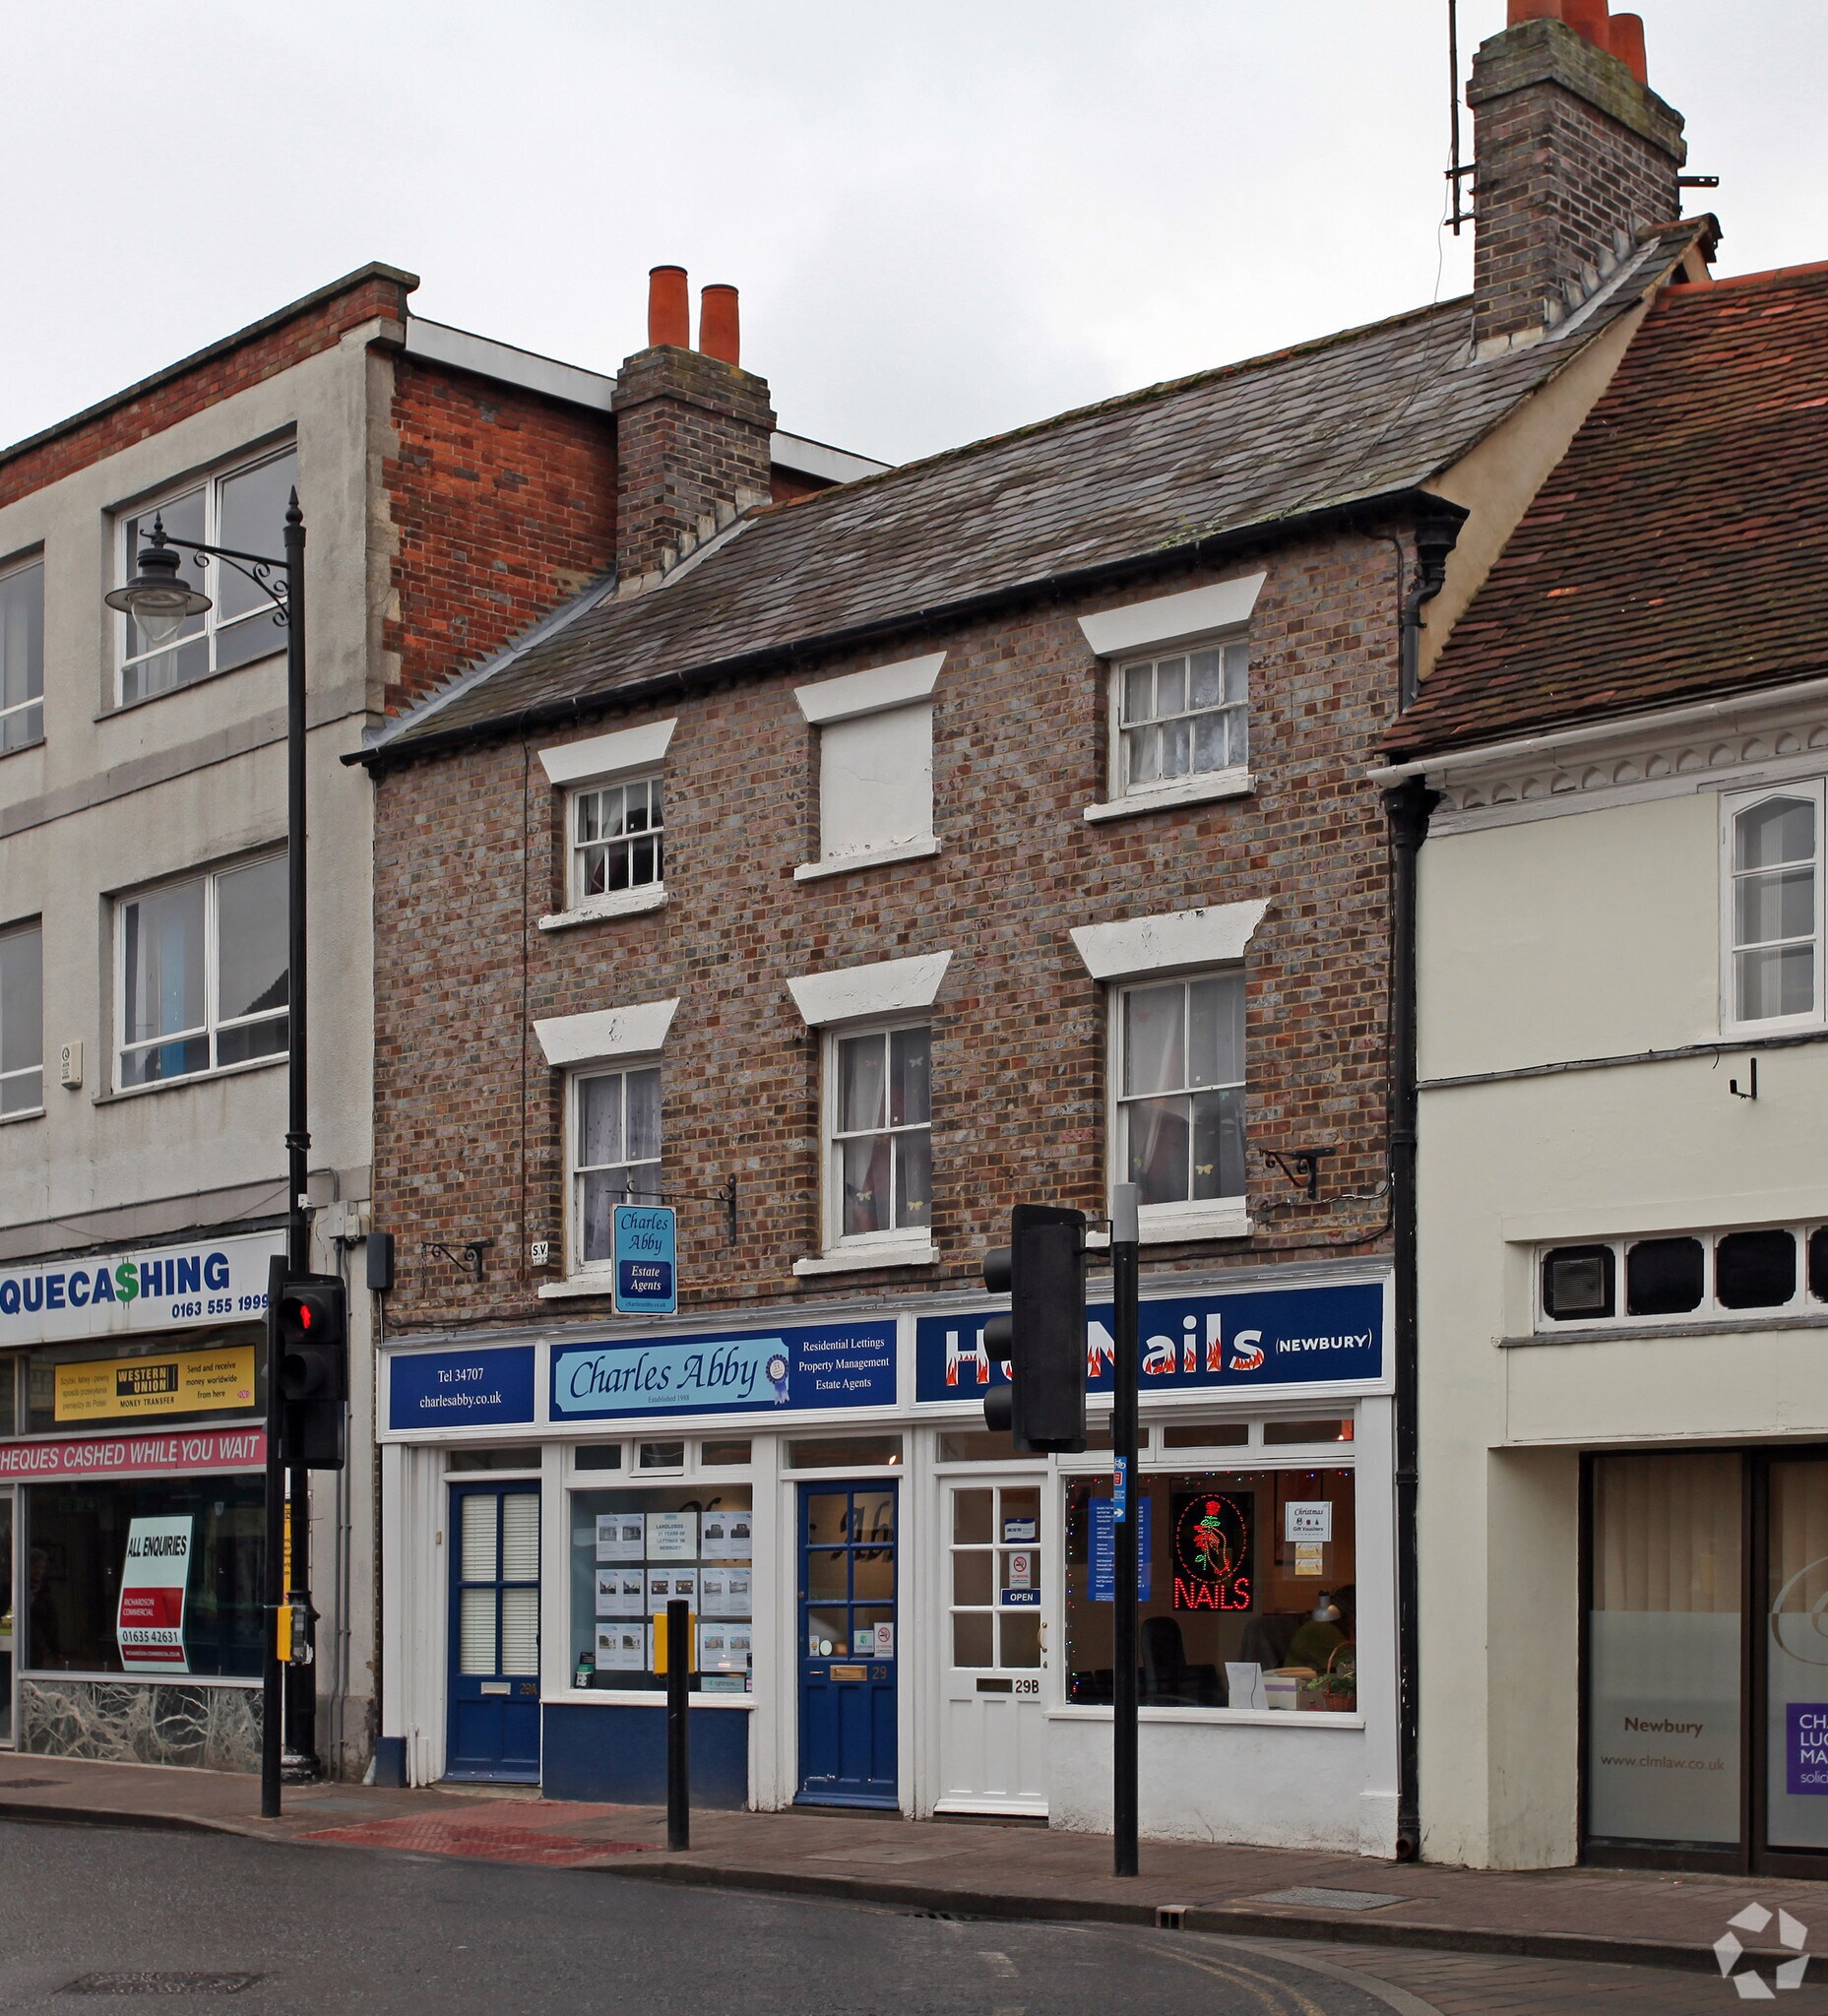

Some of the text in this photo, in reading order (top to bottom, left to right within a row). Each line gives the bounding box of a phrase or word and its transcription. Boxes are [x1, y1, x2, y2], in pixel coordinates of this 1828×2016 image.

[621, 1212, 668, 1230] Charles
[628, 1232, 662, 1256] Abby
[631, 1265, 661, 1277] Estate
[630, 1279, 662, 1293] Agents
[171, 1302, 203, 1319] 0163
[207, 1297, 232, 1314] 555
[803, 1337, 885, 1352] Residential Lettings
[1275, 1328, 1373, 1355] (NEWBURY)
[187, 1361, 236, 1374] Send and receive
[798, 1360, 834, 1373] Property
[835, 1356, 890, 1370] Management
[118, 1366, 166, 1382] WESTERN
[185, 1374, 237, 1387] money worldwide
[438, 1367, 484, 1383] Tel 34707
[569, 1347, 759, 1399] Charles Abby
[134, 1380, 166, 1394] UNION
[815, 1378, 872, 1391] Estate Agents
[197, 1389, 225, 1399] from here
[419, 1390, 502, 1409] charlesabby.co.uk
[119, 1396, 175, 1408] MONEY TRANSFER
[0, 1435, 260, 1471] HEQUES CASHED WHILE YOU WAIT
[1293, 1507, 1324, 1516] Christmas
[127, 1535, 187, 1558] ALL ENQUIRIES
[1010, 1593, 1034, 1602] OPEN
[1173, 1577, 1251, 1609] NAILS
[122, 1630, 178, 1643] 01635 42631
[872, 1666, 887, 1680] 29
[1015, 1679, 1040, 1694] 29B
[1624, 1717, 1703, 1738] Newbury
[1600, 1755, 1725, 1771] www.clmlaw.co.uk
